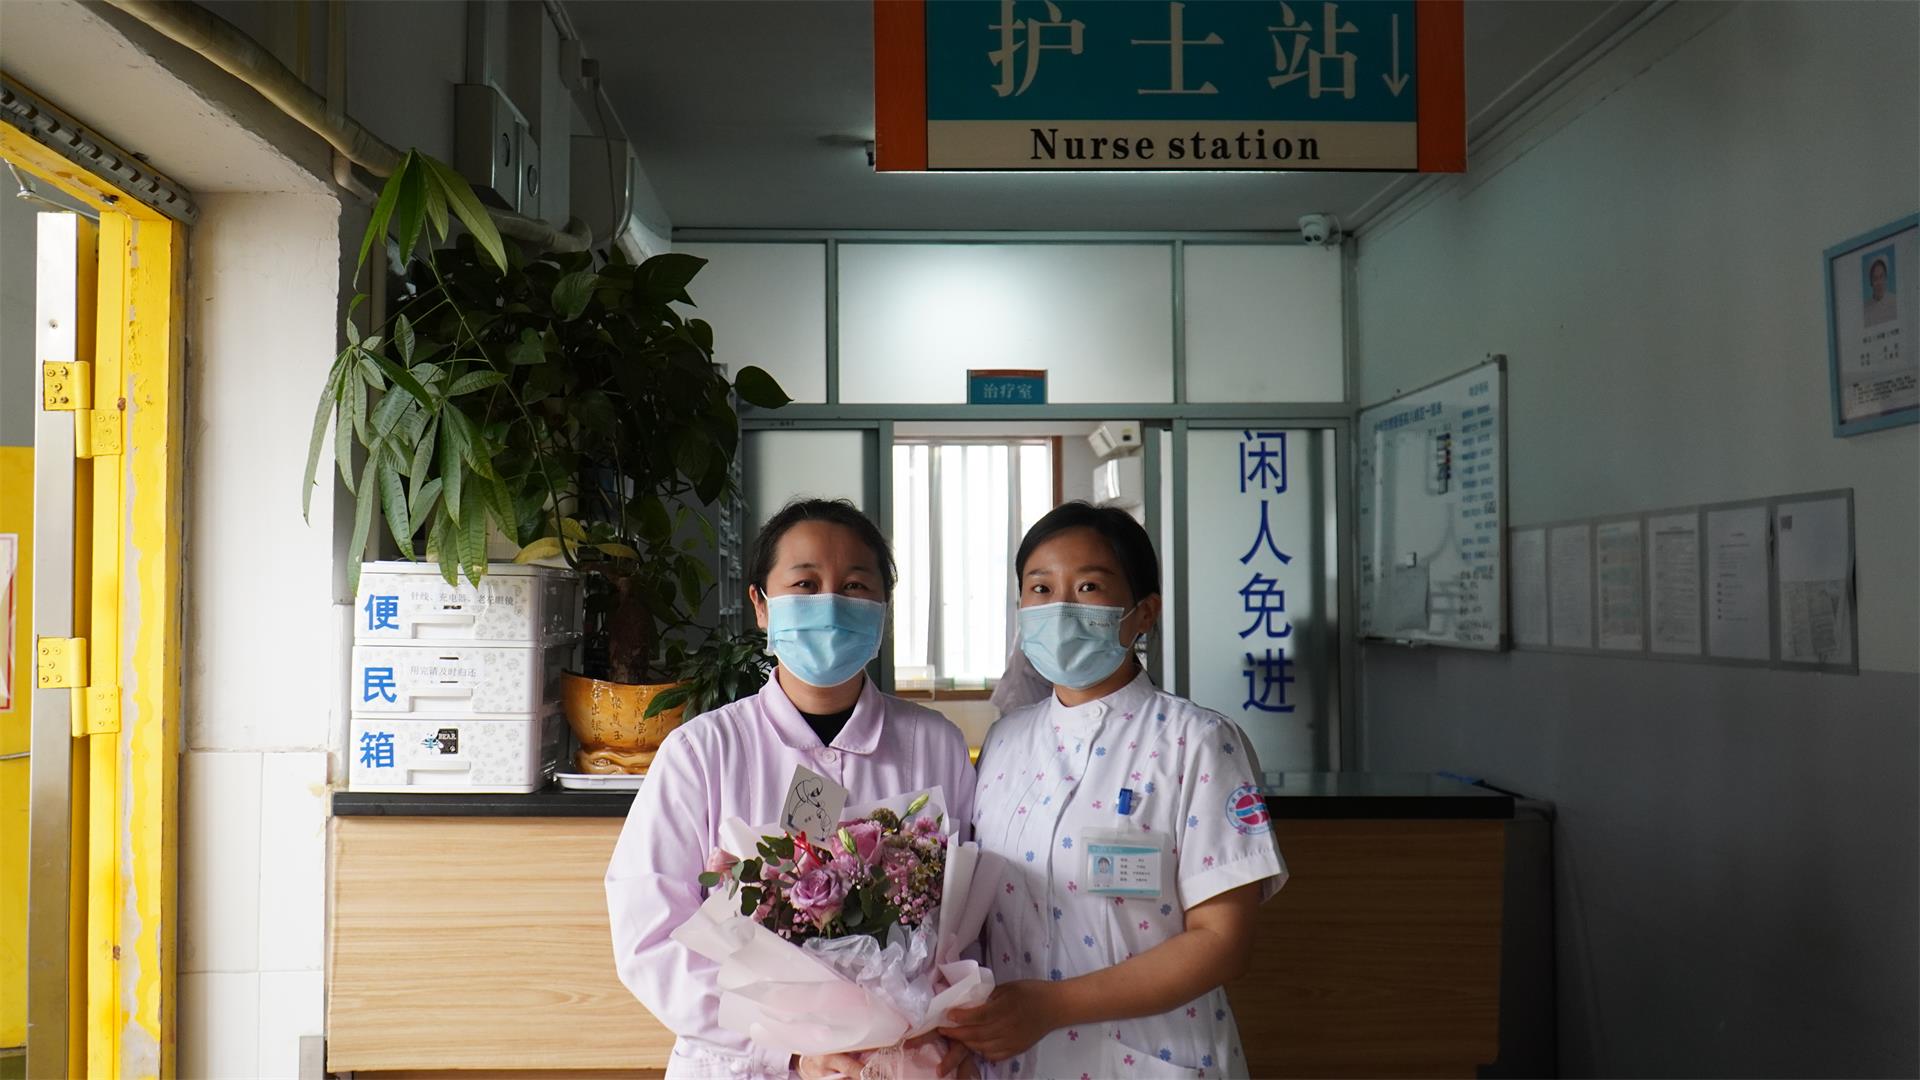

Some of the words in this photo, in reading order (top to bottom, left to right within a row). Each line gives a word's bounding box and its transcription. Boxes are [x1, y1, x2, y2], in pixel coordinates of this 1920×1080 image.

[987, 0, 1360, 99] 护士站
[1030, 127, 1154, 160] Nurse
[1168, 127, 1321, 160] station
[983, 383, 1033, 400] 治疗室
[1238, 428, 1296, 714] 闲人免进
